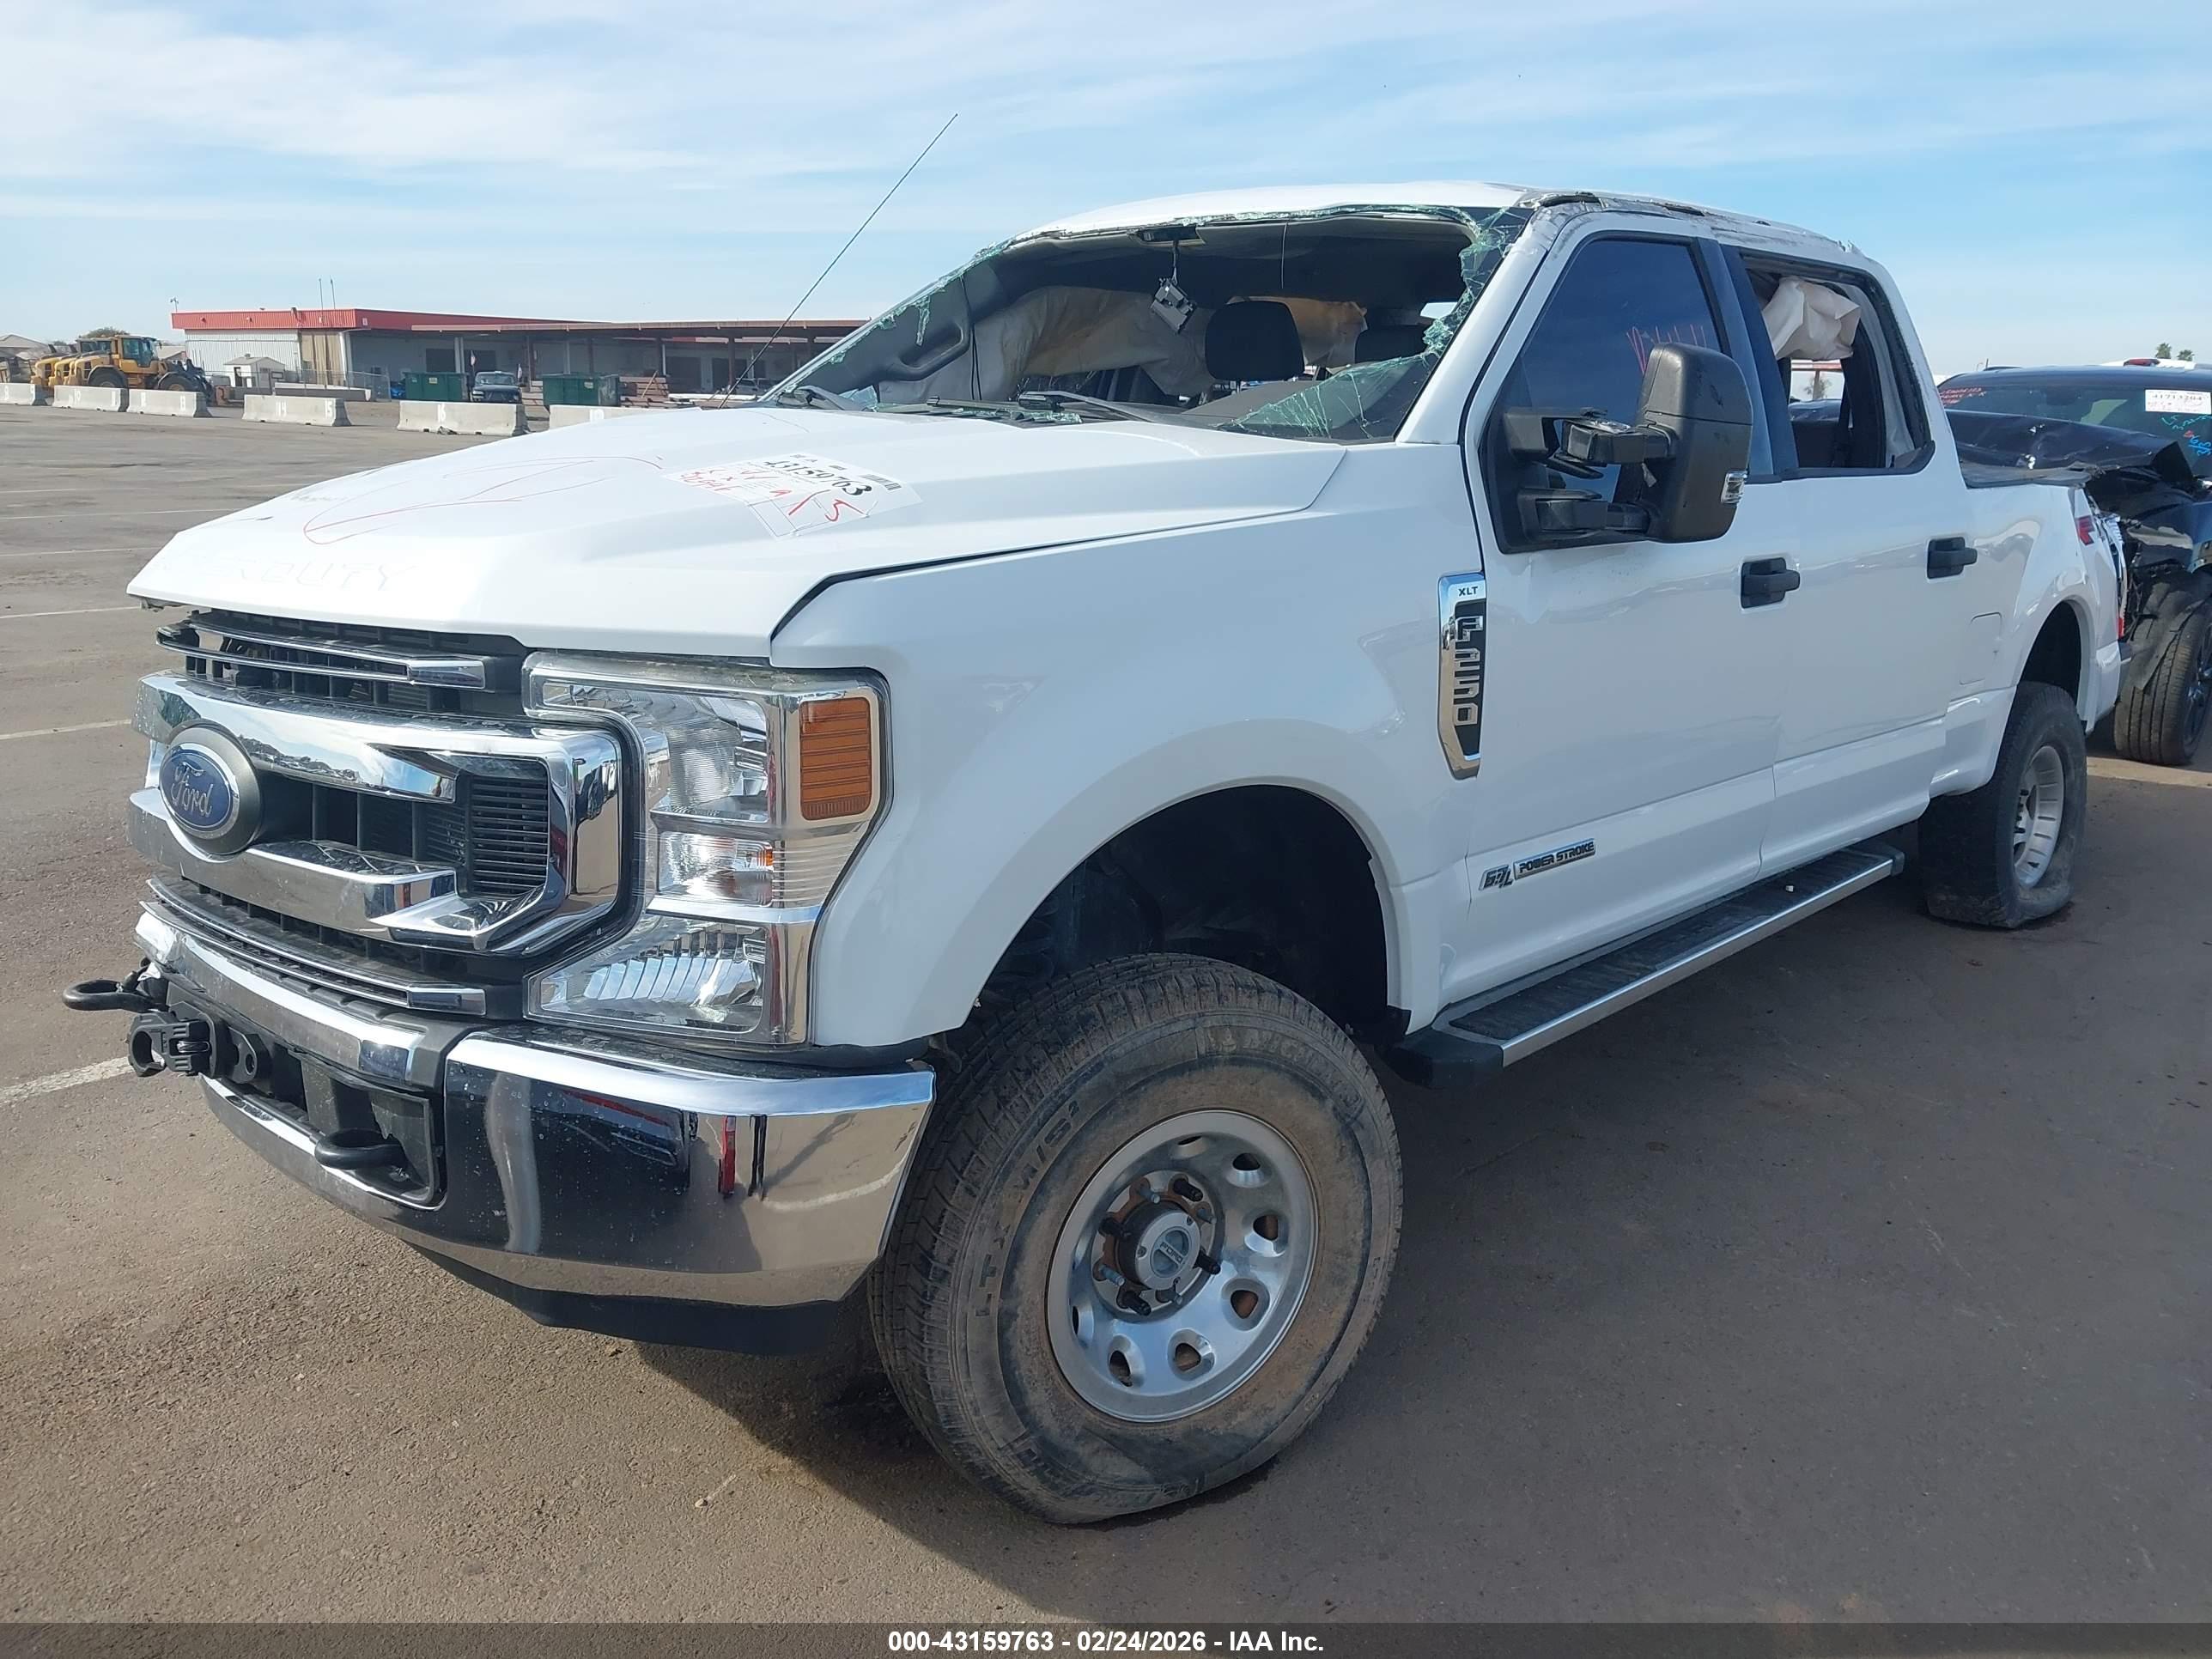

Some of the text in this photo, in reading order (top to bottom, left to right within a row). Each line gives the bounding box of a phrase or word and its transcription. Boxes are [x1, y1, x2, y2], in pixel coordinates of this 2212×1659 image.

[438, 404, 447, 422] 16
[1458, 586, 1479, 597] XLT
[170, 761, 214, 818] Ford
[1519, 854, 1555, 874] POWER
[1556, 842, 1595, 863] STROKE
[1159, 1242, 1184, 1264] FORD
